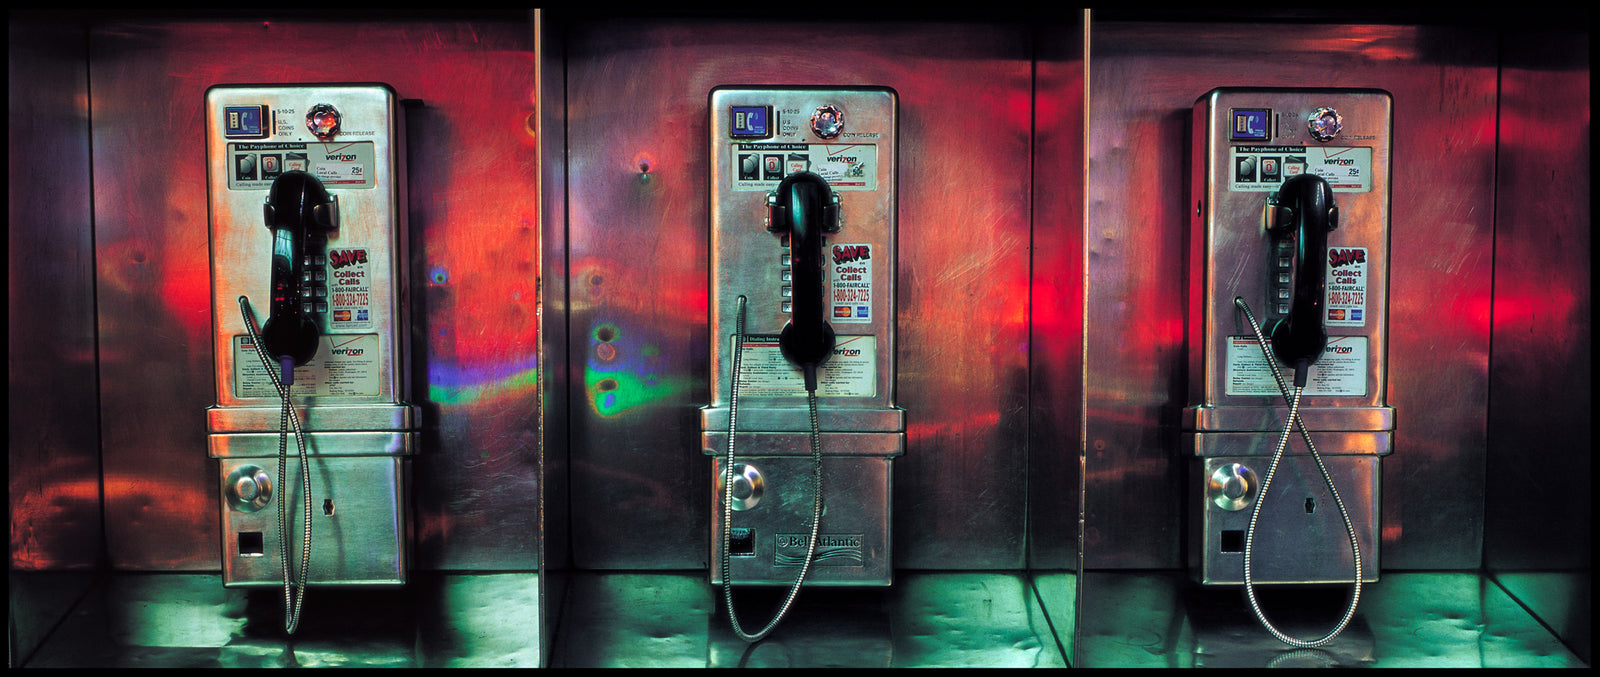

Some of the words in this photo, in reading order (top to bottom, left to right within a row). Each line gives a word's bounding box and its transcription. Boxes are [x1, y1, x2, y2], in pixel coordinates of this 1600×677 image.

[326, 153, 357, 162] verizon
[827, 154, 857, 163] verizon
[1324, 157, 1354, 166] verizon
[329, 249, 368, 270] SAVE
[832, 245, 870, 265] SAVE
[1328, 249, 1366, 268] SAVE
[1332, 269, 1362, 277] Collect
[332, 293, 369, 306] 1-800-324-7225
[833, 289, 869, 302] 1-800-324-7225
[1328, 292, 1364, 305] 1-800-324-7225
[331, 347, 364, 356] verizon
[834, 347, 861, 357] erizon
[1326, 345, 1352, 354] erizon
[817, 535, 861, 548] Atlantic
